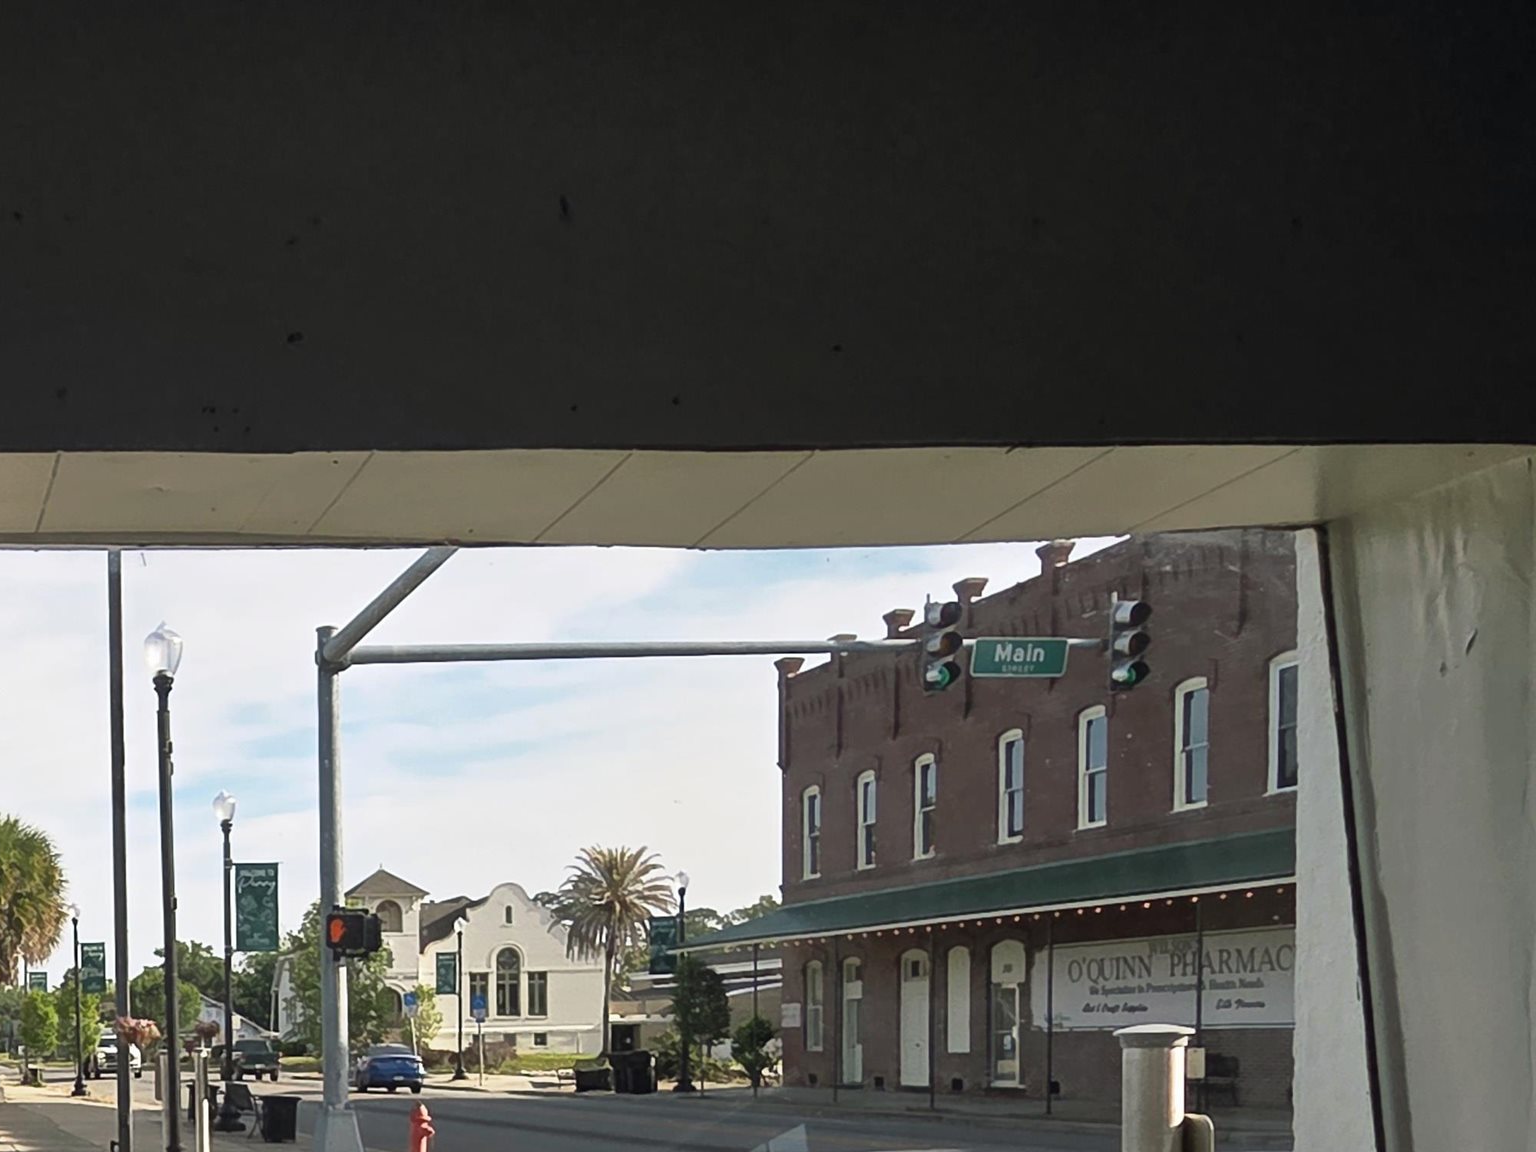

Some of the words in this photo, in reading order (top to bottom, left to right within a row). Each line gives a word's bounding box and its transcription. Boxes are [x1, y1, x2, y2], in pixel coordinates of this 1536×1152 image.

[994, 643, 1045, 662] Main
[1067, 954, 1153, 985] O'QUINN
[1169, 944, 1296, 977] PHARMAC
